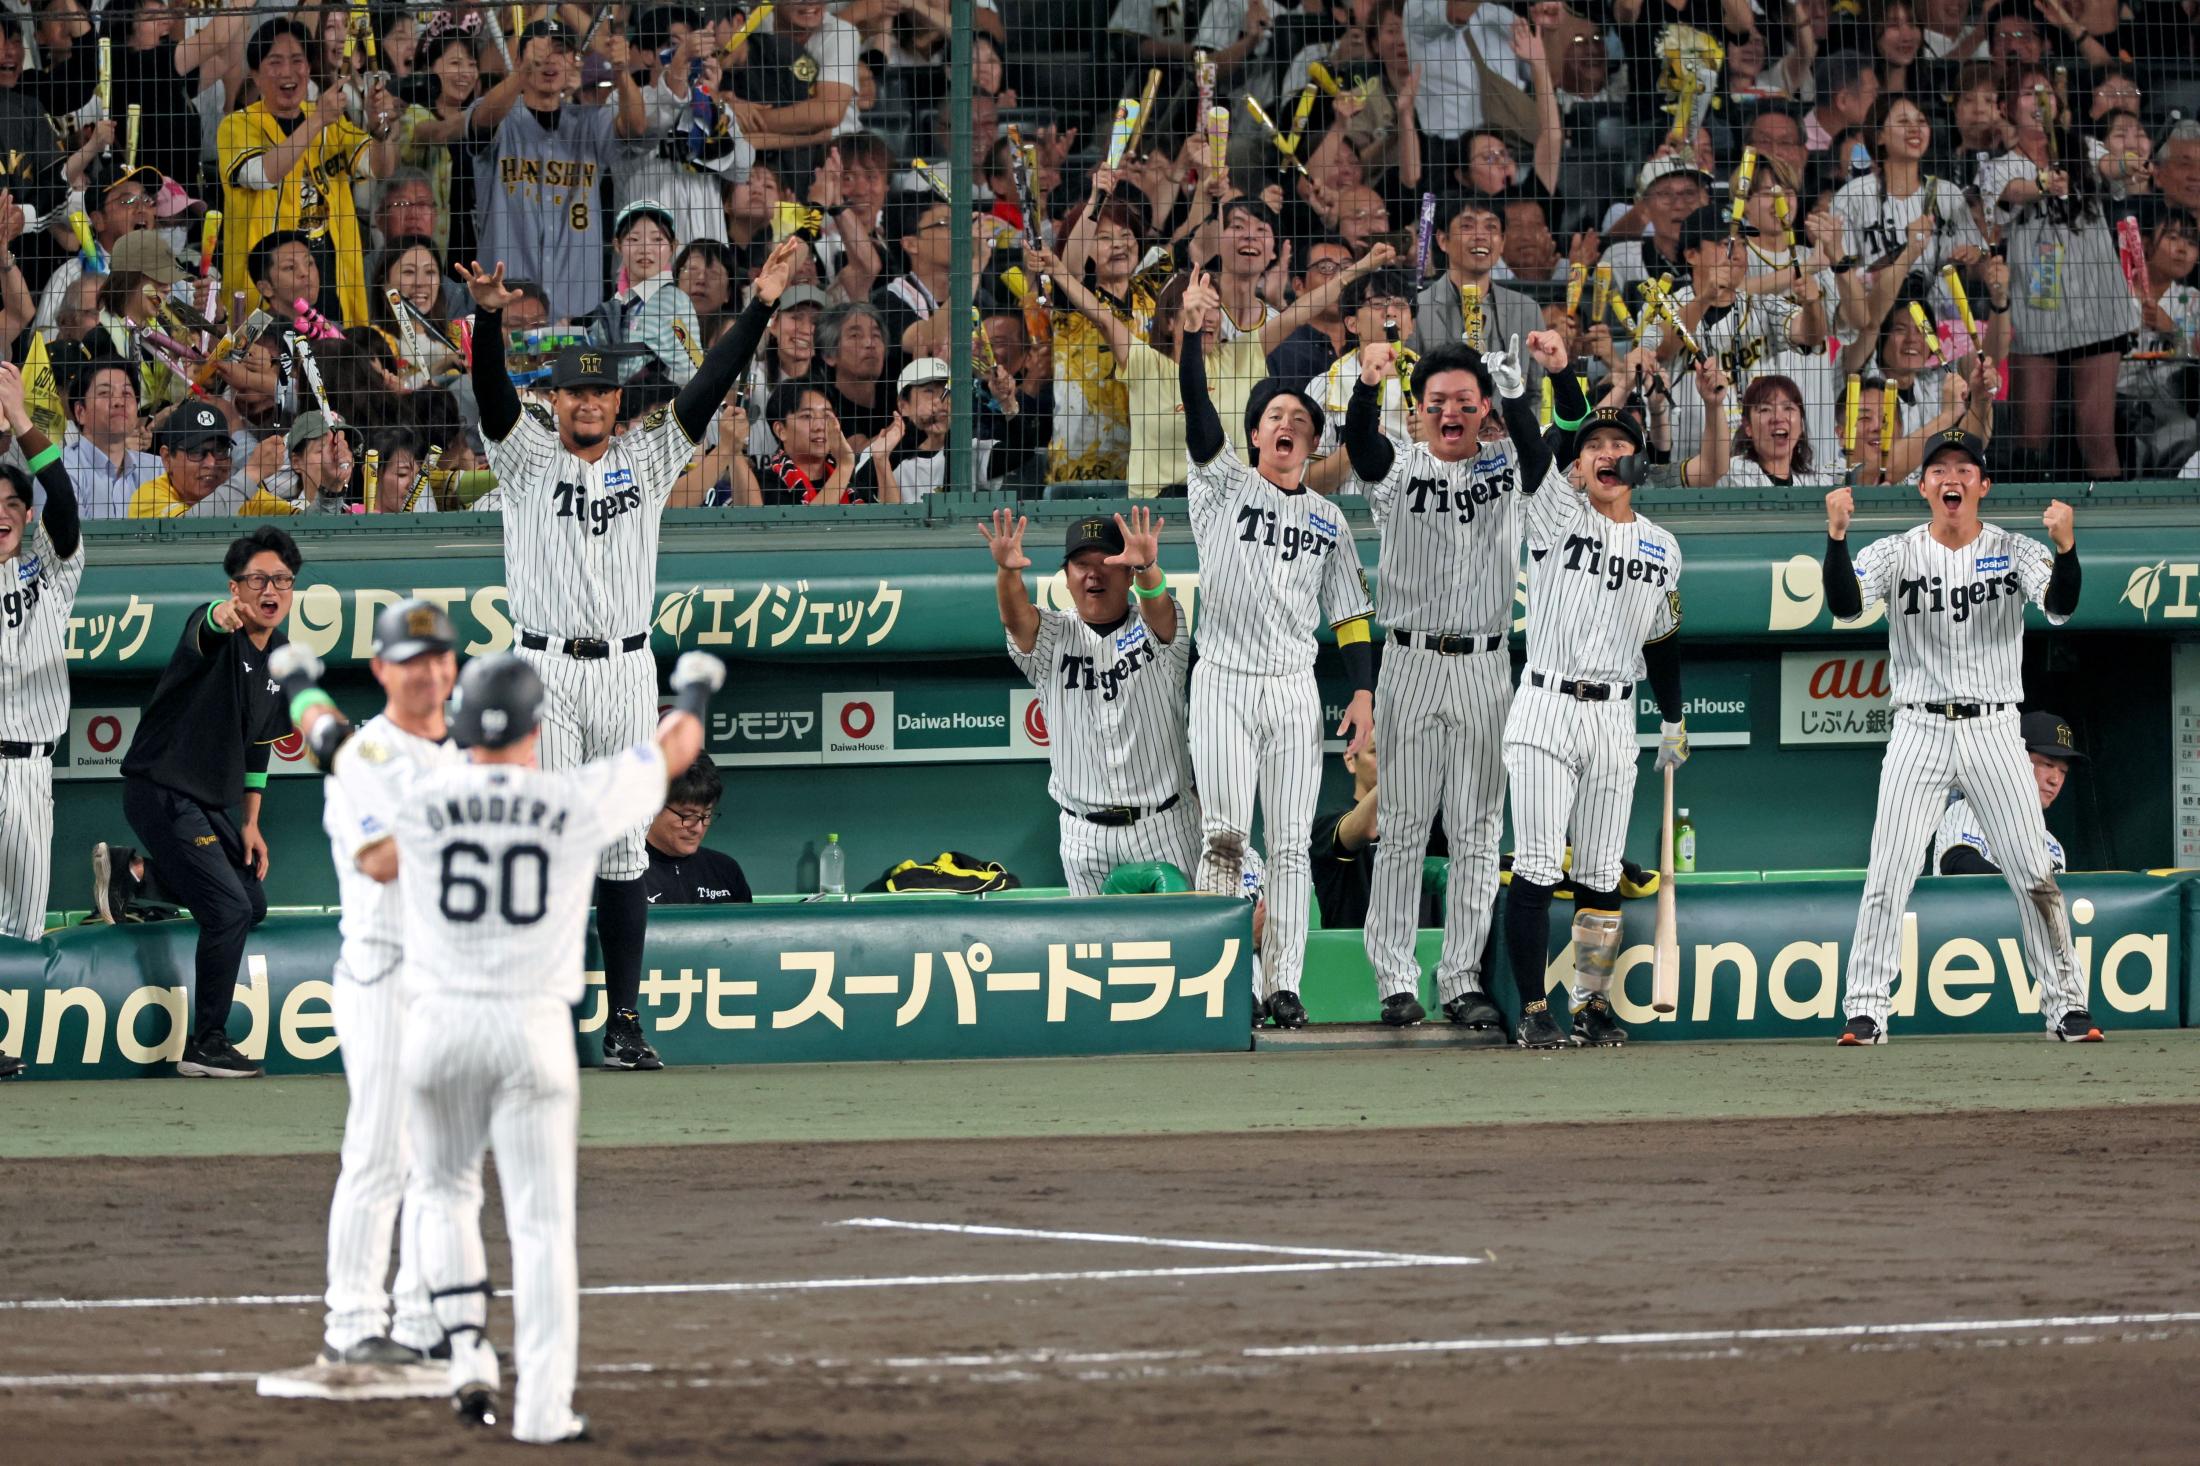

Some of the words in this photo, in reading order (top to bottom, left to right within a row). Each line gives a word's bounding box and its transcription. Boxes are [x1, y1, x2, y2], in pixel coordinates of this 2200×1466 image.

[571, 203, 588, 230] 8
[553, 480, 640, 536] Tigers
[1406, 468, 1514, 523] Tigers
[1564, 533, 1668, 590] Tigers
[1977, 557, 2008, 569] Joshin
[697, 580, 902, 648] エイジェック
[1899, 571, 2018, 622] Tigers
[1060, 640, 1155, 700] Tigers
[1809, 659, 1891, 699] au
[898, 714, 951, 730] Daiwa
[953, 712, 1005, 729] House
[1640, 699, 1691, 714] Daa
[1694, 697, 1745, 714] House
[713, 711, 814, 742] シモジマ
[77, 757, 104, 766] Daiwa
[831, 743, 857, 752] Daiwa
[858, 743, 884, 752] House
[426, 795, 567, 836] ONODERA
[440, 841, 548, 925] 60
